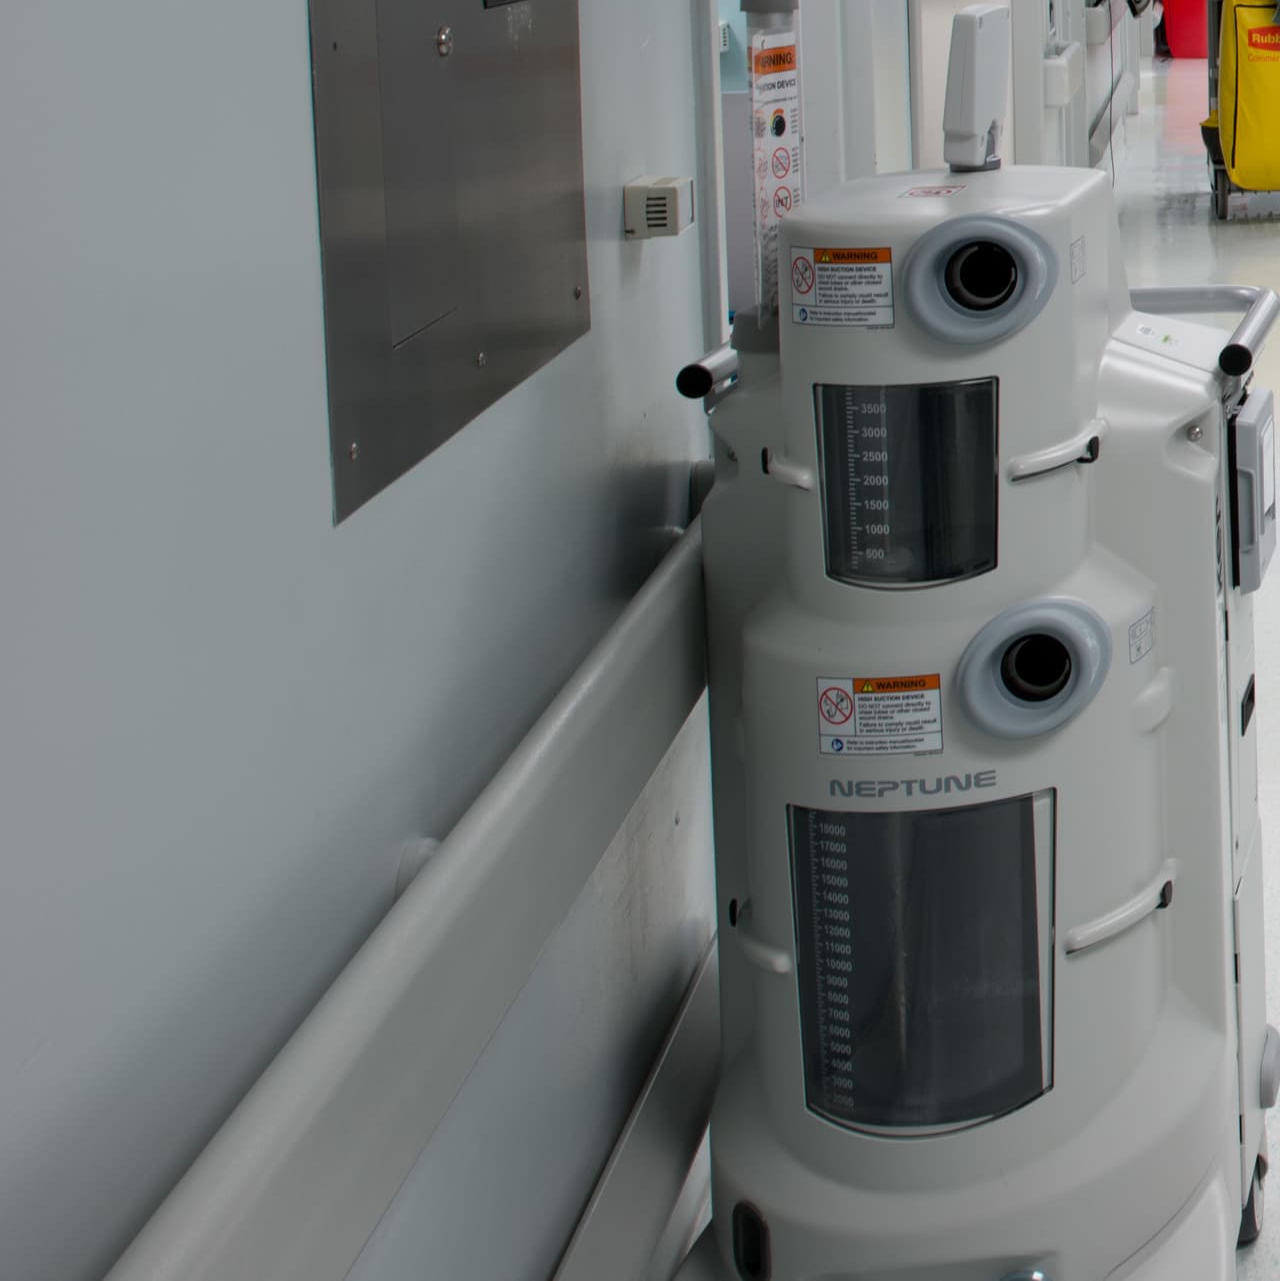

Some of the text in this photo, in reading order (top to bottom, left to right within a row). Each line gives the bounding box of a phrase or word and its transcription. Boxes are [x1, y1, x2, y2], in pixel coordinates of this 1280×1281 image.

[832, 252, 878, 260] WARNING
[861, 403, 886, 414] 3500
[861, 427, 887, 438] 3000
[862, 451, 888, 462] 2500
[863, 476, 889, 486] 2000
[864, 500, 889, 510] 1500
[865, 524, 890, 535] 1000
[865, 549, 885, 559] 500
[876, 679, 926, 690] WARNING
[829, 769, 997, 798] NEPTUNE
[819, 823, 846, 837] 18000
[819, 840, 847, 854] 17000
[820, 857, 847, 871] 16000
[821, 873, 848, 888] 15000
[822, 890, 849, 904] 14000
[823, 907, 850, 921] 13000
[824, 925, 850, 938] 12000
[824, 941, 851, 955] 11000
[825, 958, 852, 972] 10000
[826, 975, 848, 988] 9000
[828, 1008, 850, 1022] 7000
